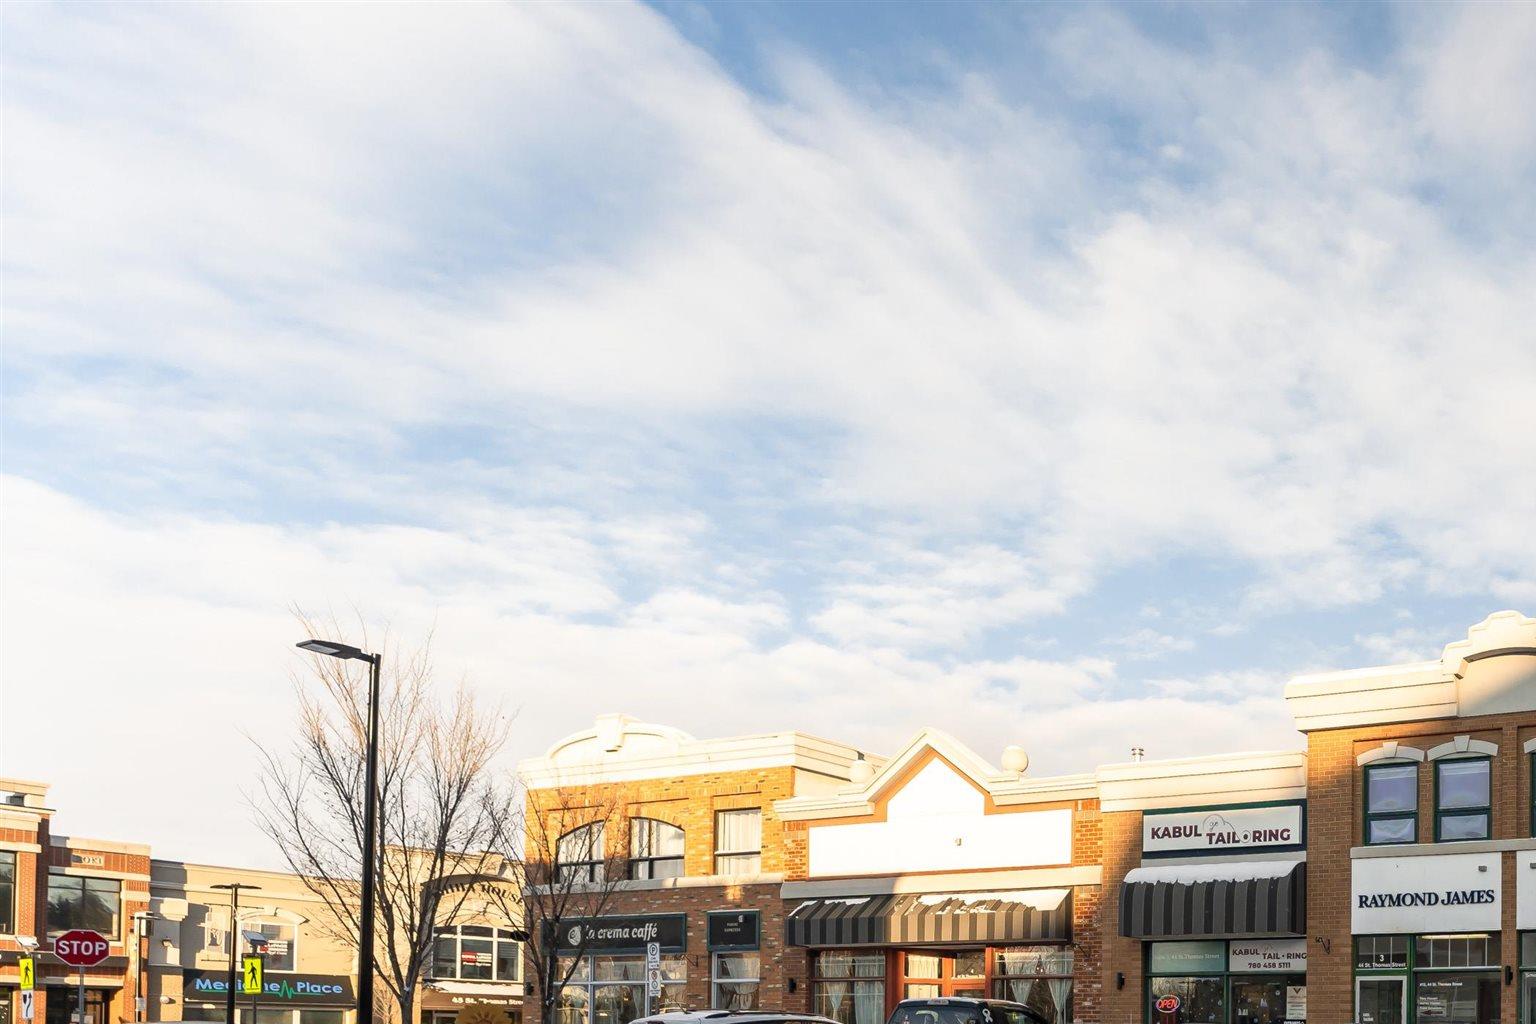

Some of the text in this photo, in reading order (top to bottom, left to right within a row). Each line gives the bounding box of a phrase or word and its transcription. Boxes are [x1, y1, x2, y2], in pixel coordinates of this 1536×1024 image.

[1151, 825, 1202, 839] KABUL
[1358, 889, 1495, 908] RAYMOND JAMES
[597, 928, 630, 939] crema
[58, 940, 107, 955] STOP
[297, 982, 343, 994] Place
[1158, 998, 1179, 1008] OPEN
